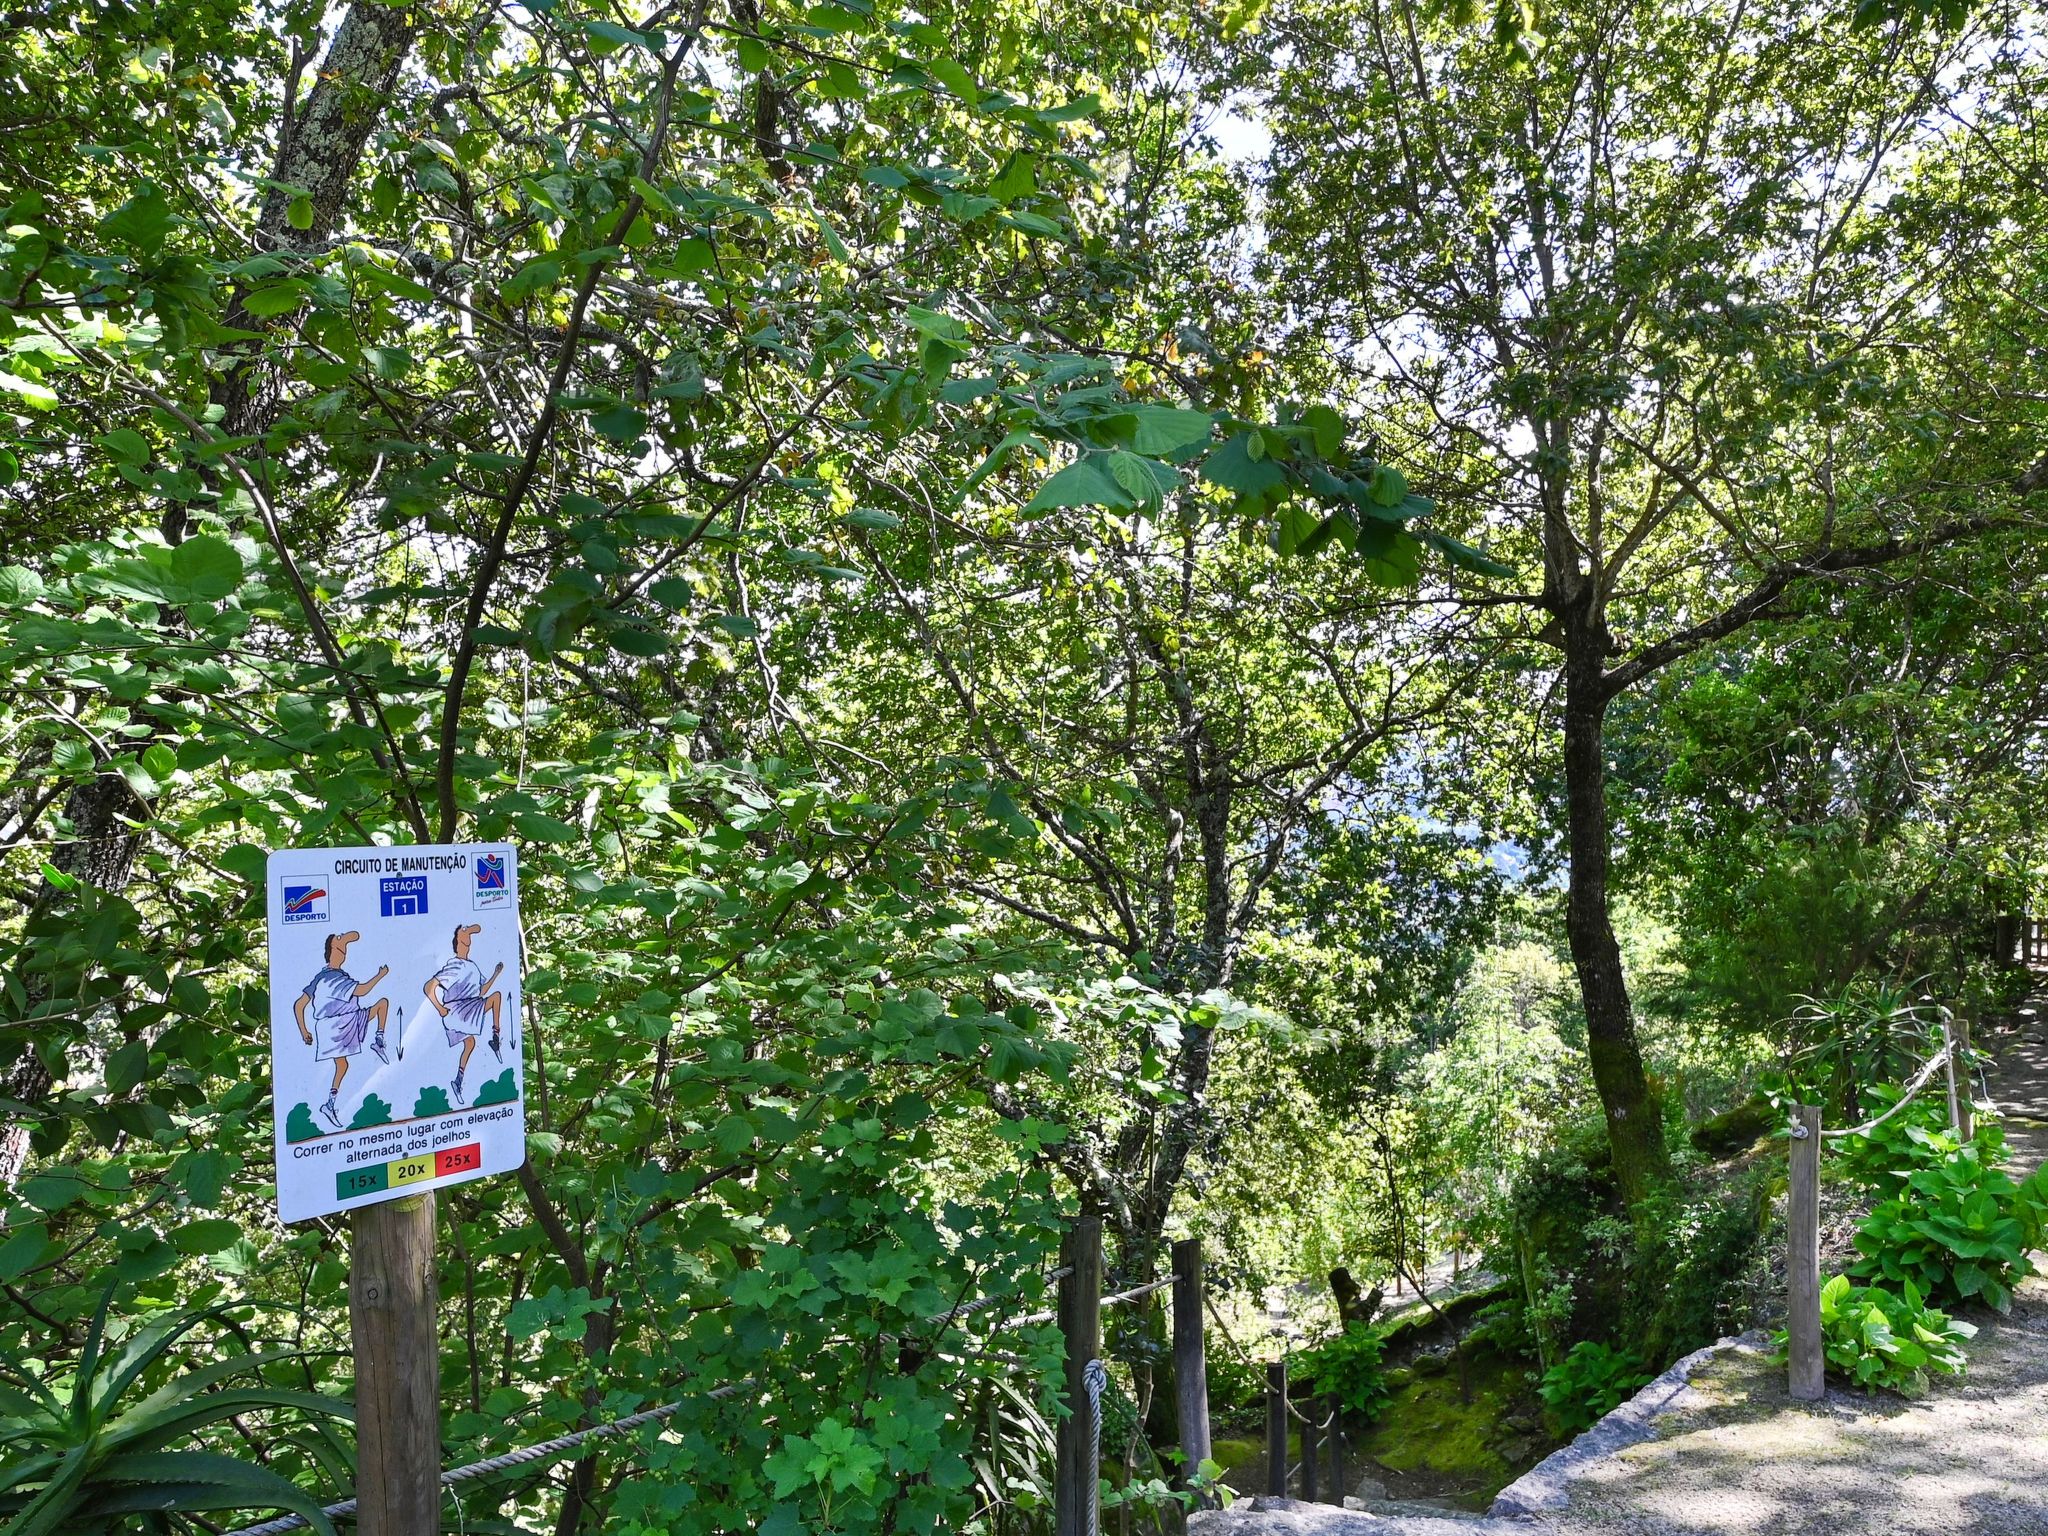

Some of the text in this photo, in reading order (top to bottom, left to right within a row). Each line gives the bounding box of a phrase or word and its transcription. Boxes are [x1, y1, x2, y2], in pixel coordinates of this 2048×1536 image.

[334, 852, 466, 874] CIRCUITO DE MANUTENÇÃO
[383, 878, 424, 893] ESTAÇÃO
[476, 889, 509, 898] DESPORTO
[284, 912, 326, 922] DESPORTO
[402, 904, 406, 914] 1
[294, 1107, 514, 1158] Correr no mesmo lugar com elevação
[346, 1130, 471, 1164] alternada dos joelhos
[348, 1153, 471, 1190] 15x 20x 25x
